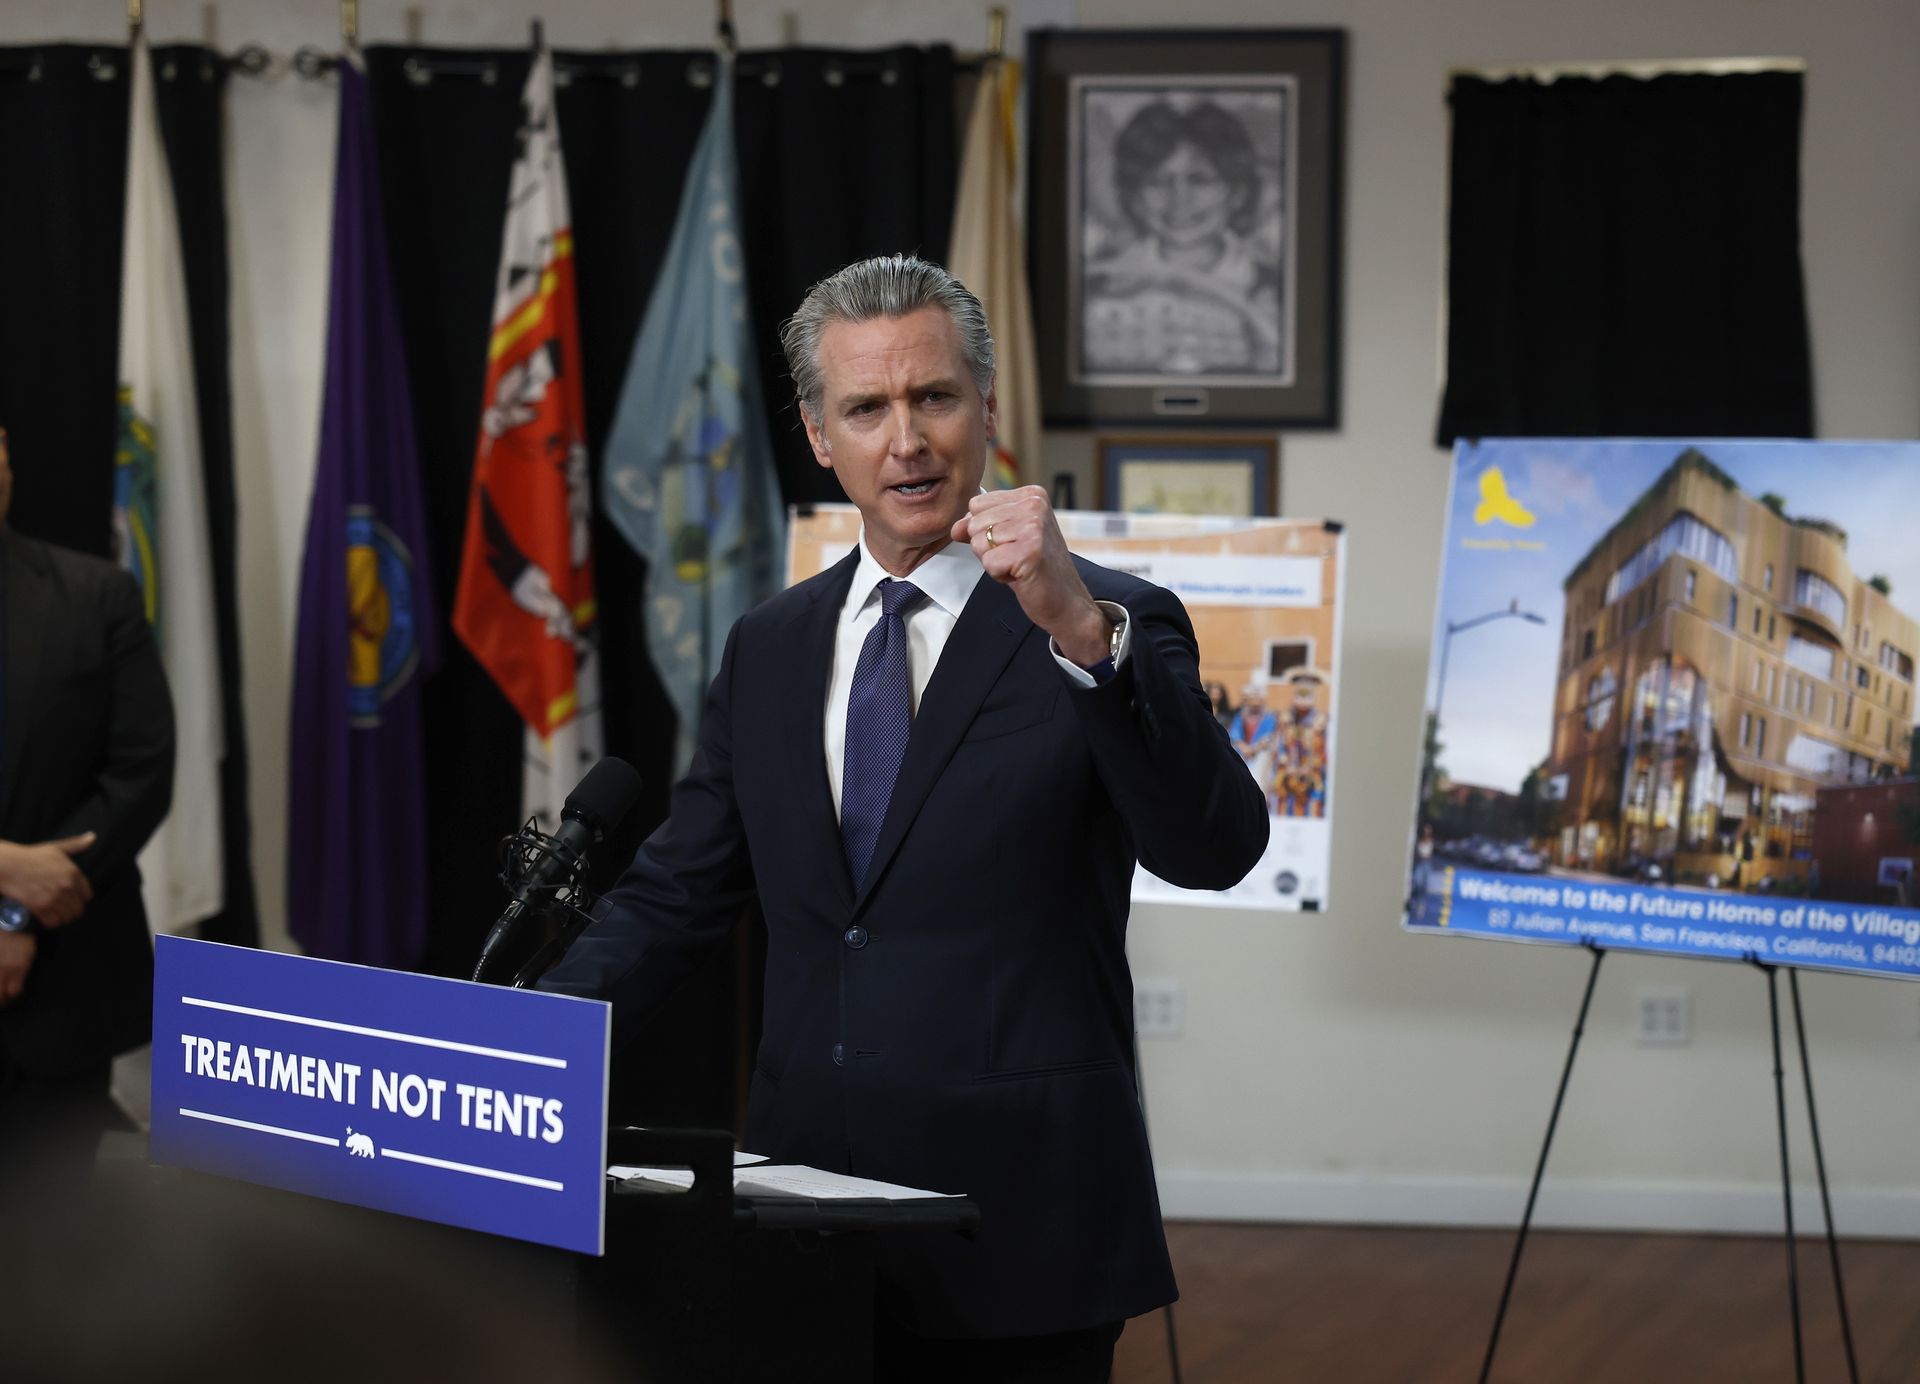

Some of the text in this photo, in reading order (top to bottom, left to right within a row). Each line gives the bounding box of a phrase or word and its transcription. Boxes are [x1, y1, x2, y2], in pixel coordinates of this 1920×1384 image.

[1459, 877, 1559, 907] Welcome
[1563, 886, 1587, 909] to
[1589, 888, 1627, 914] the
[1630, 891, 1704, 921] Future
[1706, 899, 1776, 927] Home
[1779, 905, 1805, 929] of
[1807, 907, 1847, 933] the
[1852, 911, 1920, 945] Villag
[1512, 911, 1565, 933] Julian
[1640, 922, 1675, 944] San
[1772, 934, 1867, 963] California,
[181, 1034, 564, 1144] TREATMENT NOT TENTS
